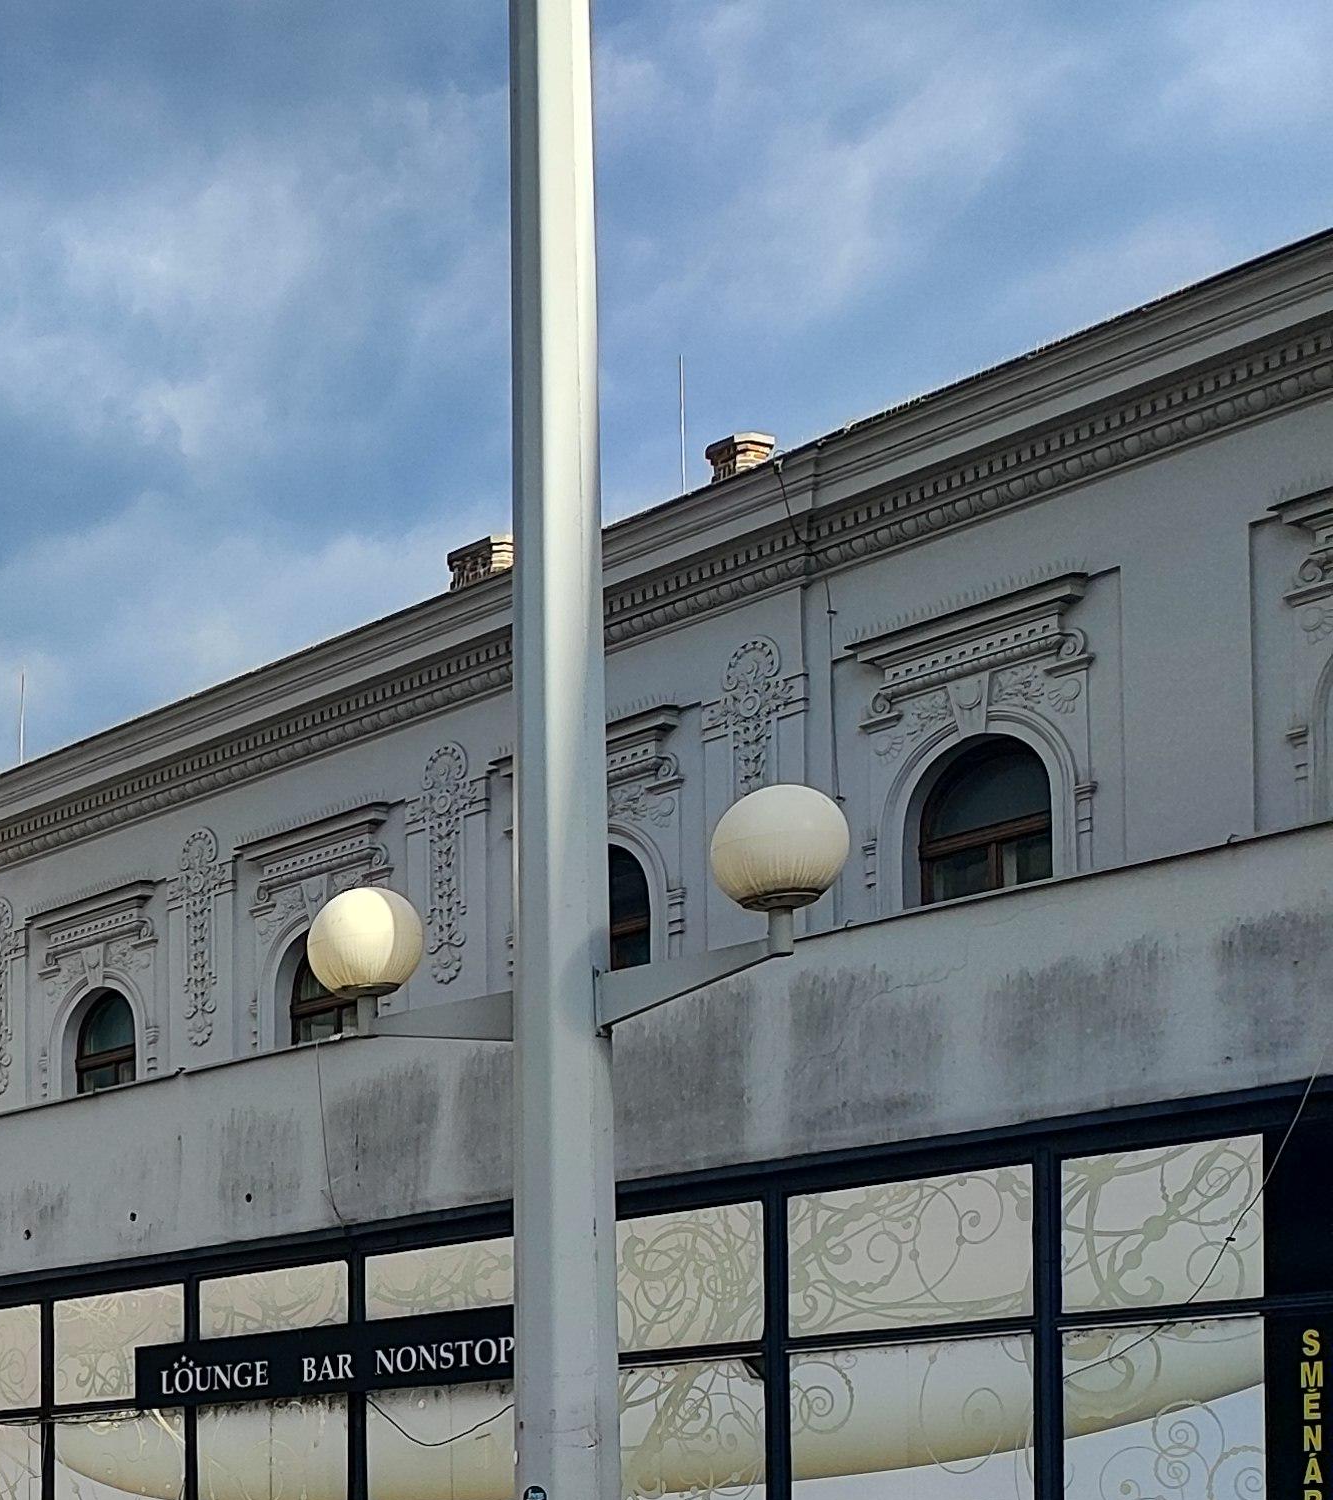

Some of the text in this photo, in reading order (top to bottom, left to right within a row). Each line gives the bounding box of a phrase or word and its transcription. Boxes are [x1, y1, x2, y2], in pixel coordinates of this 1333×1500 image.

[160, 1336, 515, 1395] LOUNGE BAR NONSTOP
